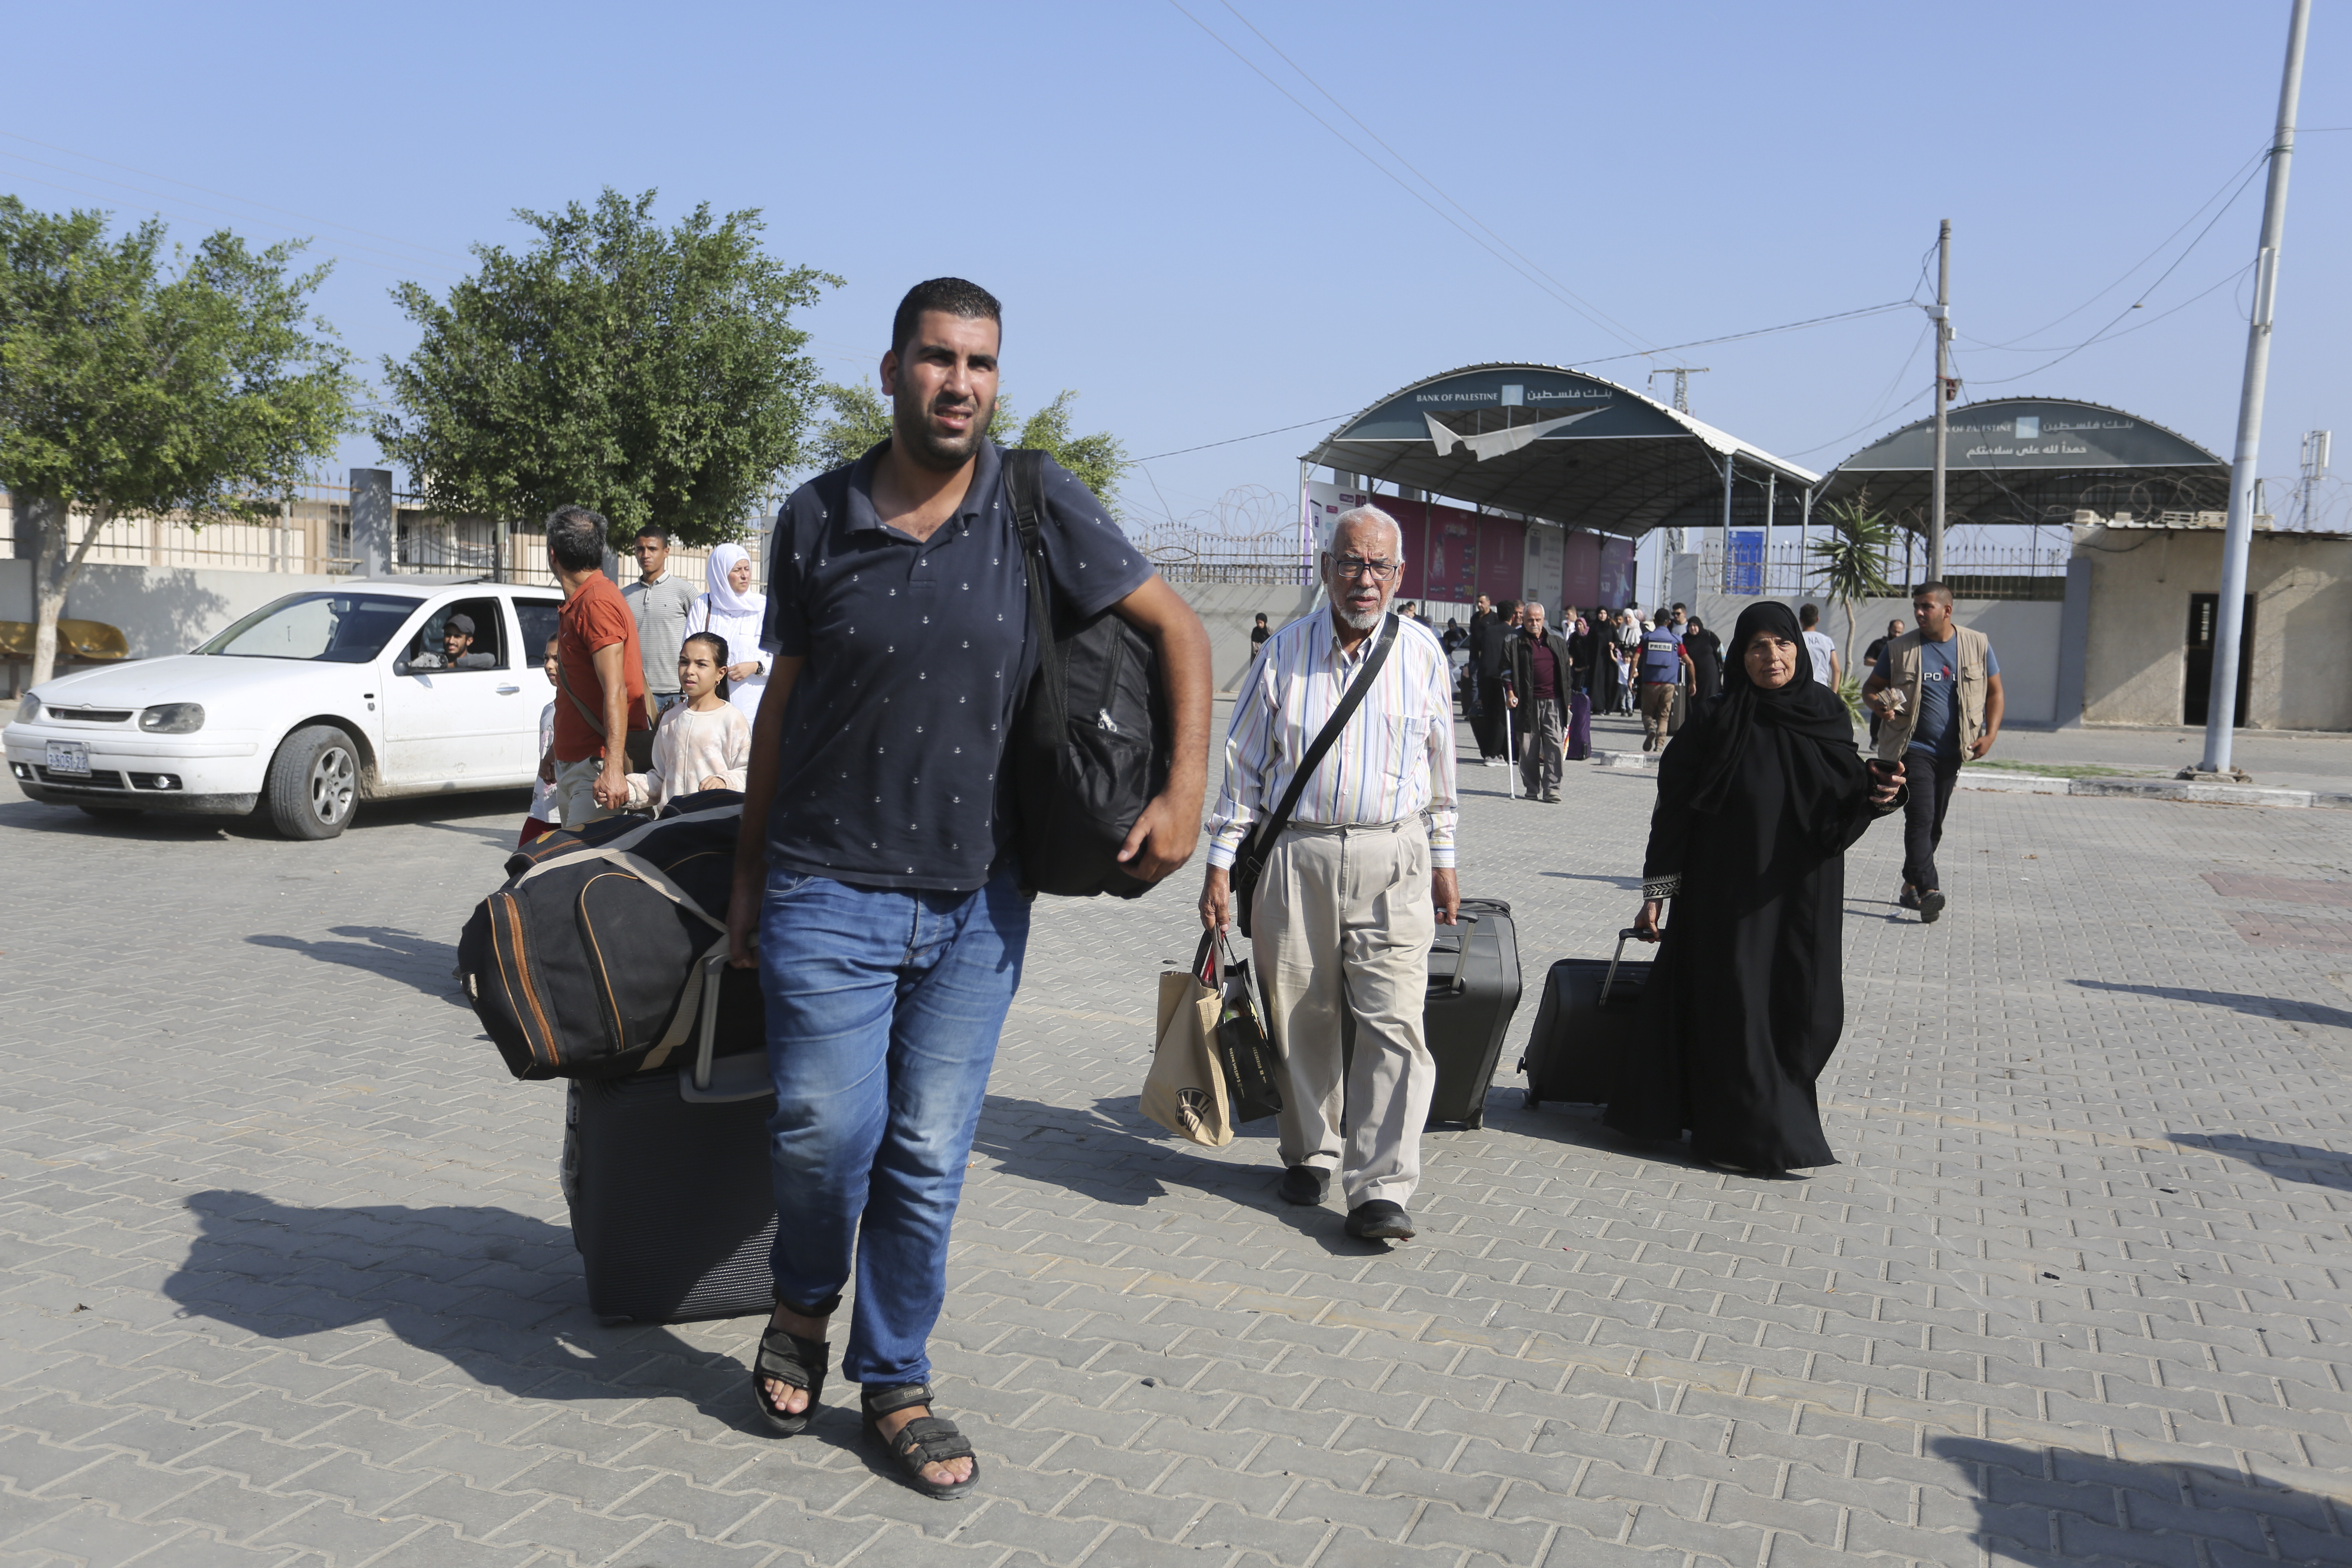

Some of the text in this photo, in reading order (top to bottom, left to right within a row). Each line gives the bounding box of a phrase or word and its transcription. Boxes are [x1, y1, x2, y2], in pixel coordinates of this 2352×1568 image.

[1454, 392, 1498, 401] PALESTINE
[1527, 388, 1612, 401] بنك فلسطين
[1951, 425, 1964, 433] OF
[1966, 424, 2012, 432] PALESTINE
[2043, 420, 2100, 432] فلسطين
[2042, 444, 2059, 454] لله
